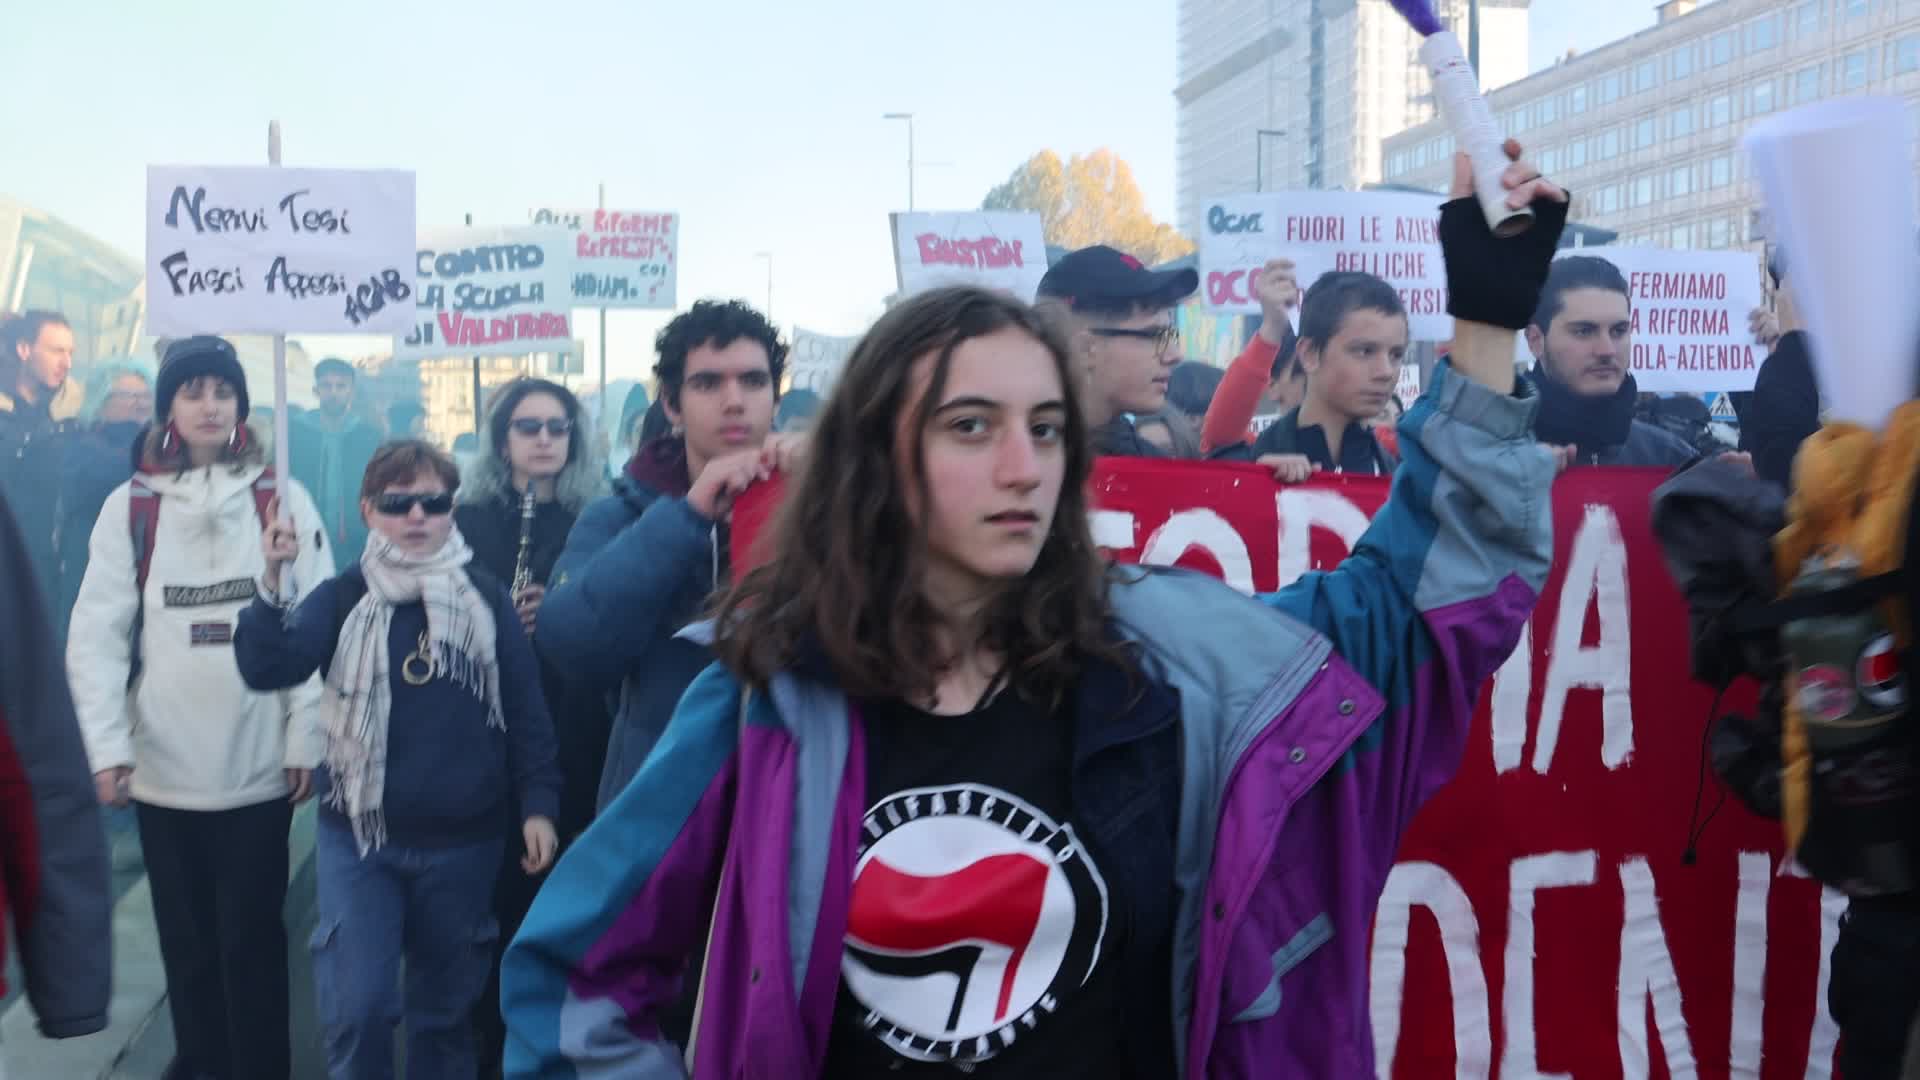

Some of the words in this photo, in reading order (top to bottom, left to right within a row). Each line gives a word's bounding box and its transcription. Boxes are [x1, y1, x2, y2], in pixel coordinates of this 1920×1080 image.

[1287, 215, 1344, 242] FUORI
[1360, 216, 1382, 242] LE
[1395, 216, 1440, 243] AZIEN
[416, 244, 544, 279] CONTRO
[915, 233, 1024, 271] EINSTEIN
[453, 280, 544, 311] SCUOLA
[1630, 272, 1726, 300] FERMIAMO
[1649, 308, 1730, 336] RIFORMA
[1630, 344, 1755, 371] OLA-AZIENDA
